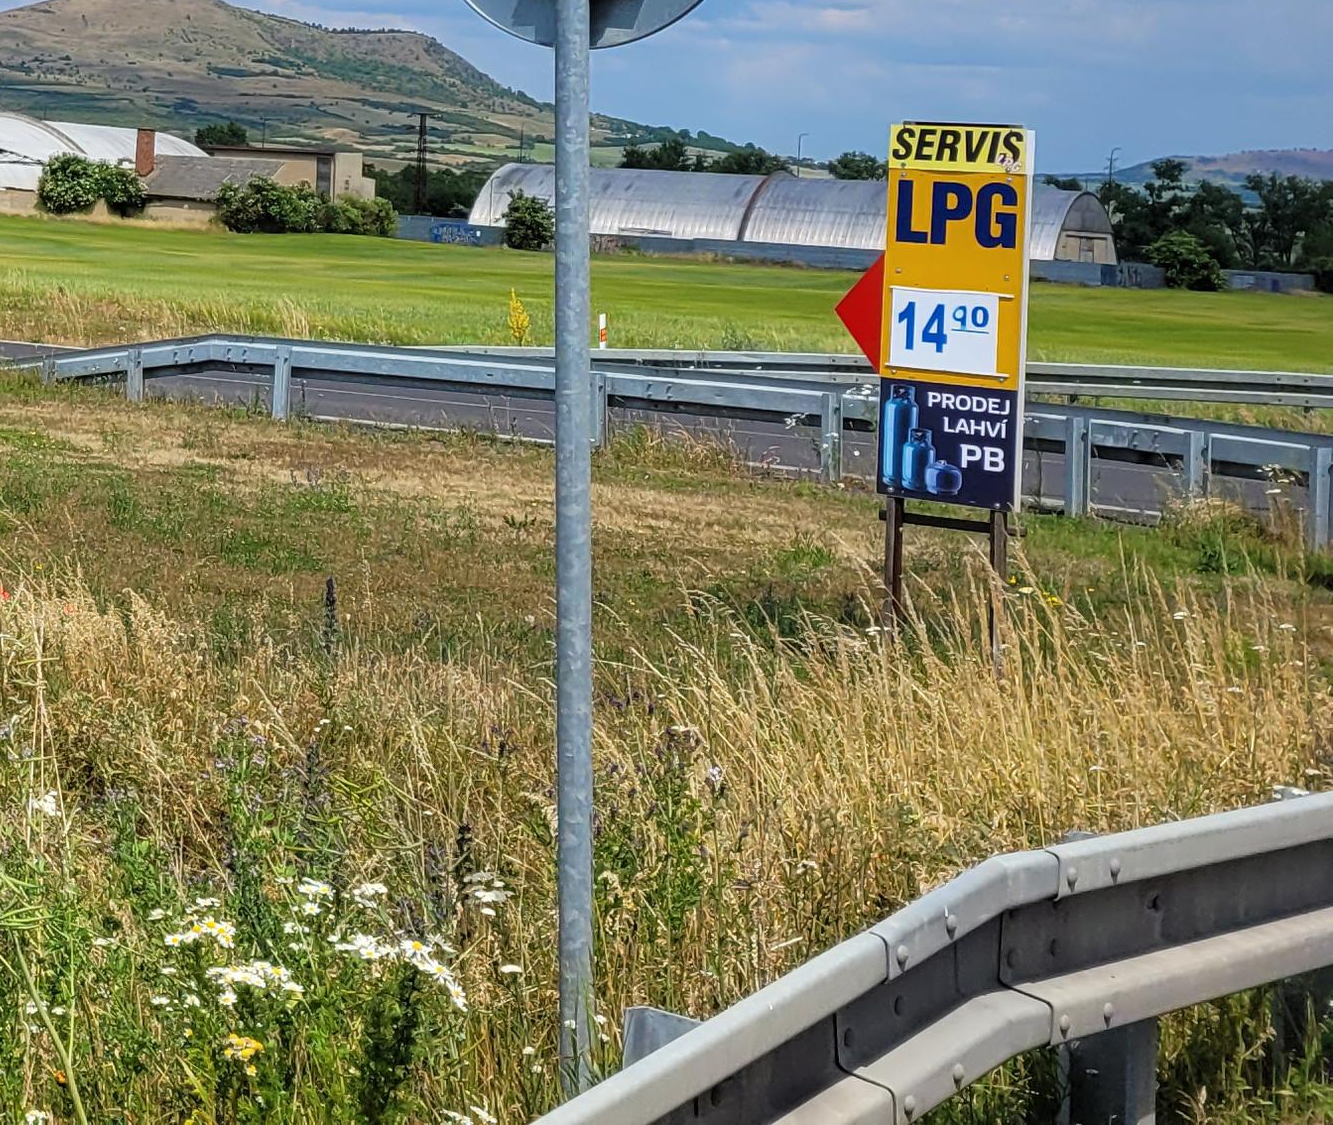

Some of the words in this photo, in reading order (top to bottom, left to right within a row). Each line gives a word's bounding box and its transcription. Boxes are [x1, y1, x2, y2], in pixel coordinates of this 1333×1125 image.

[891, 126, 1024, 165] SERVIS
[895, 179, 1019, 249] LPG
[927, 391, 1011, 416] PRODEJ
[943, 416, 1009, 440] LAHVÍ
[960, 444, 1006, 473] PB
